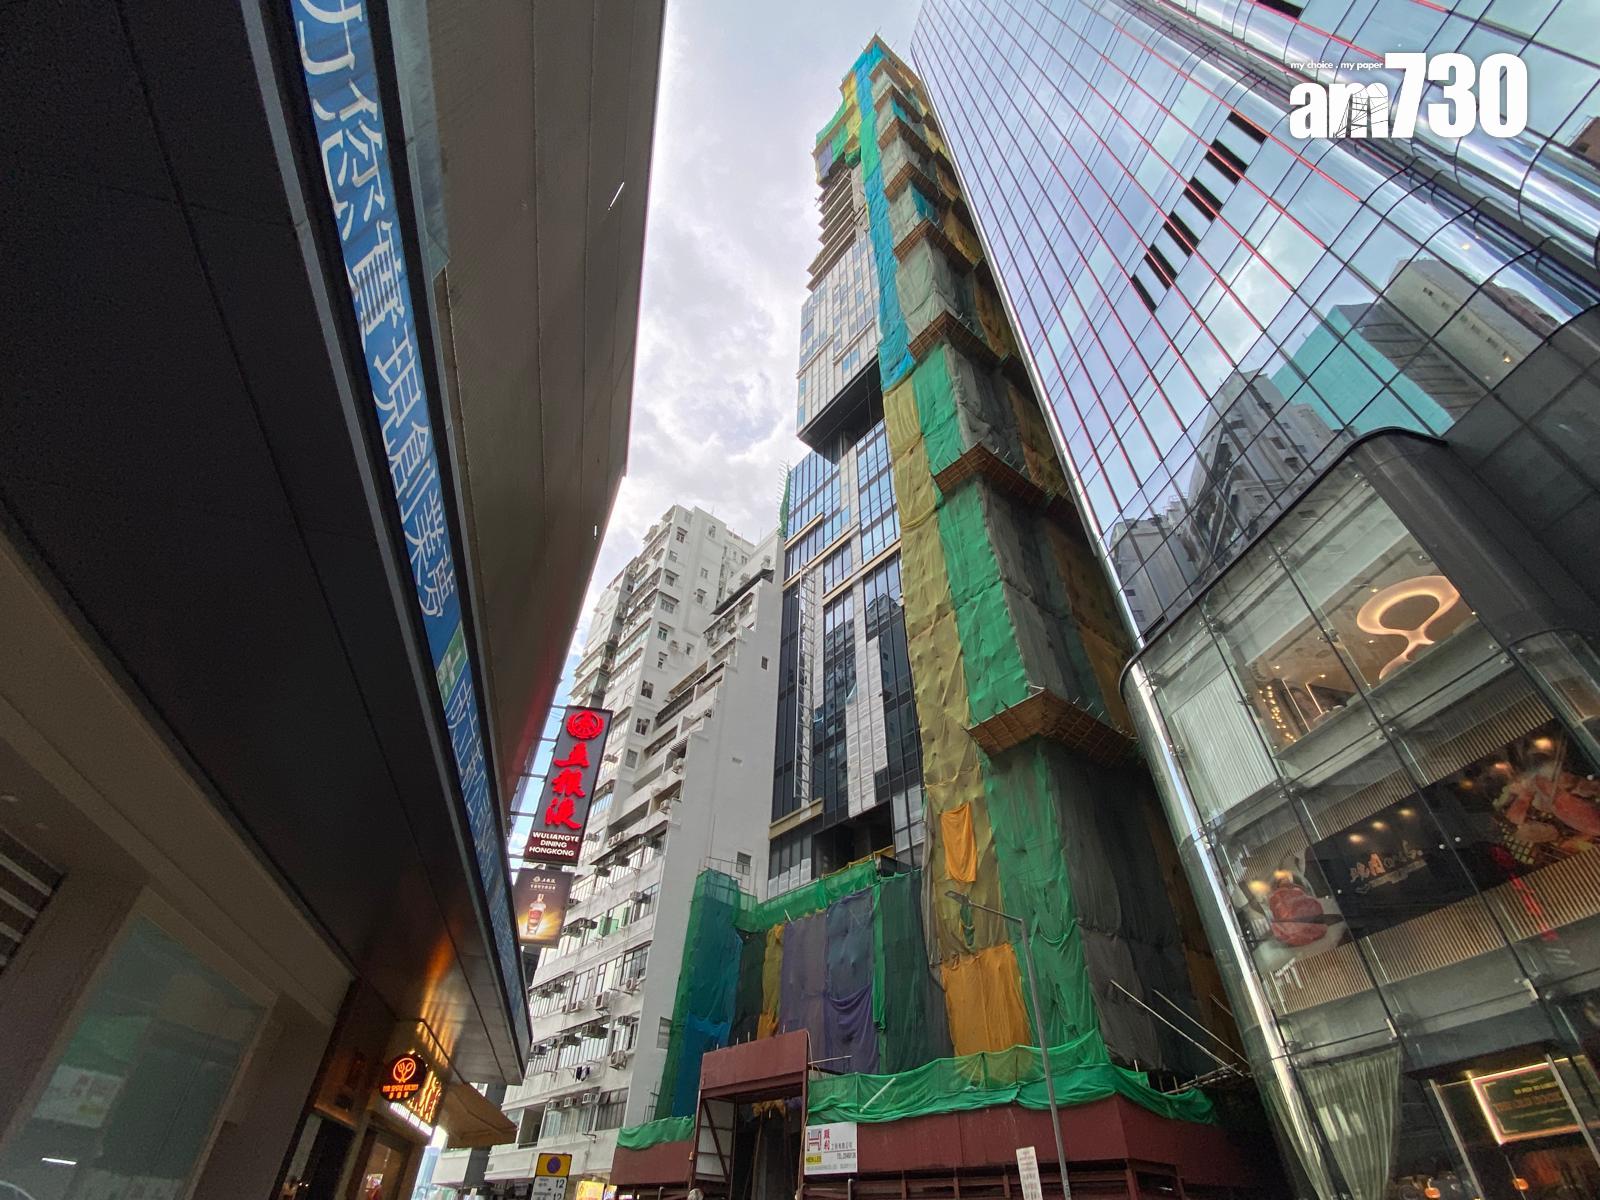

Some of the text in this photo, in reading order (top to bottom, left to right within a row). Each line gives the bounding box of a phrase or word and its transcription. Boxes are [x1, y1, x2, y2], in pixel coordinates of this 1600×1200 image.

[532, 831, 580, 843] WULIANGYE
[540, 839, 567, 849] DINING
[529, 846, 574, 857] HONGKONG
